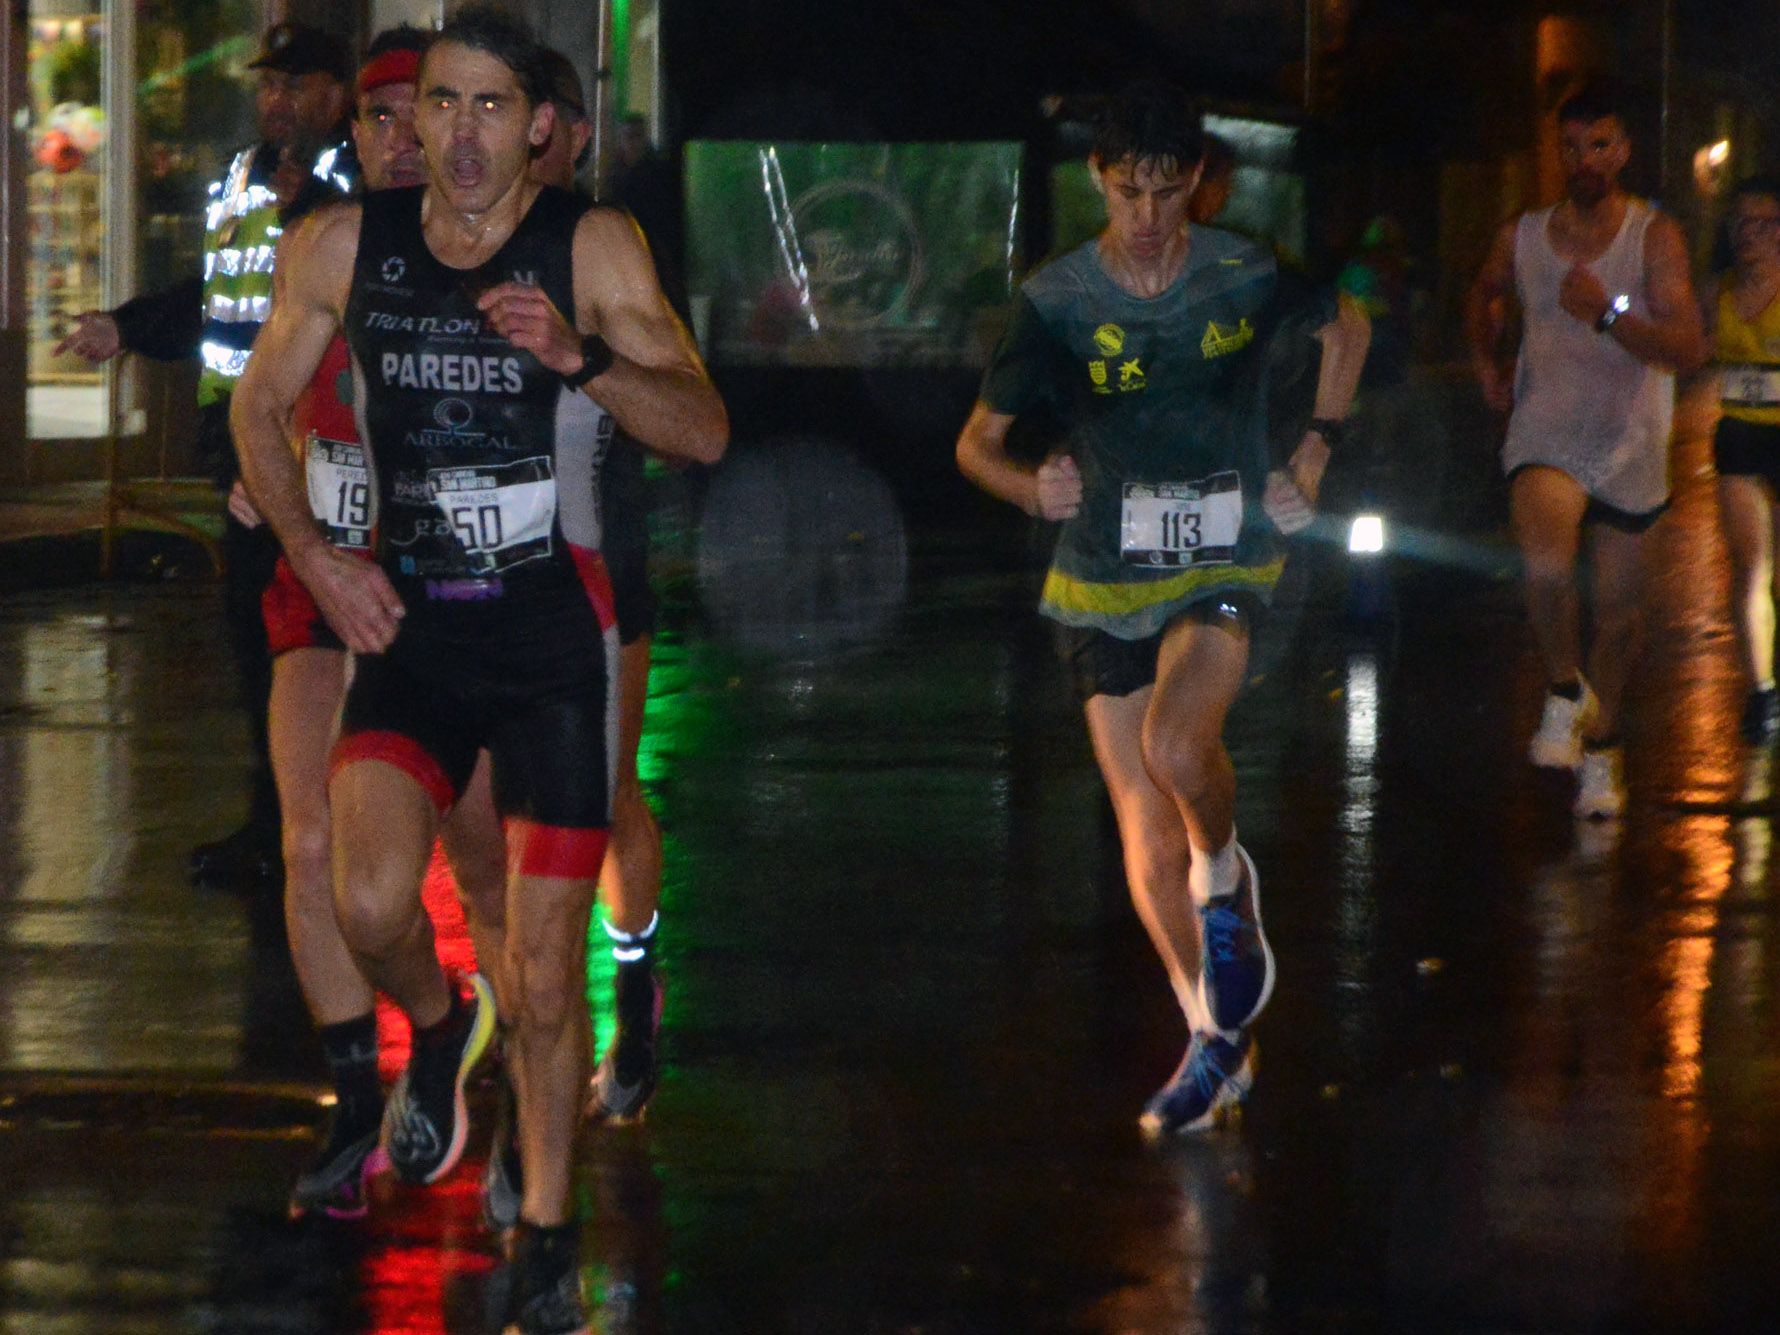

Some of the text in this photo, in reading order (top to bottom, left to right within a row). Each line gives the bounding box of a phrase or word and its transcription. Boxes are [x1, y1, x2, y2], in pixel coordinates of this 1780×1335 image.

[365, 312, 480, 335] TRIATLON
[382, 352, 523, 394] PAREDES
[338, 481, 368, 526] 19
[452, 504, 502, 548] 50
[1161, 511, 1201, 548] 113
